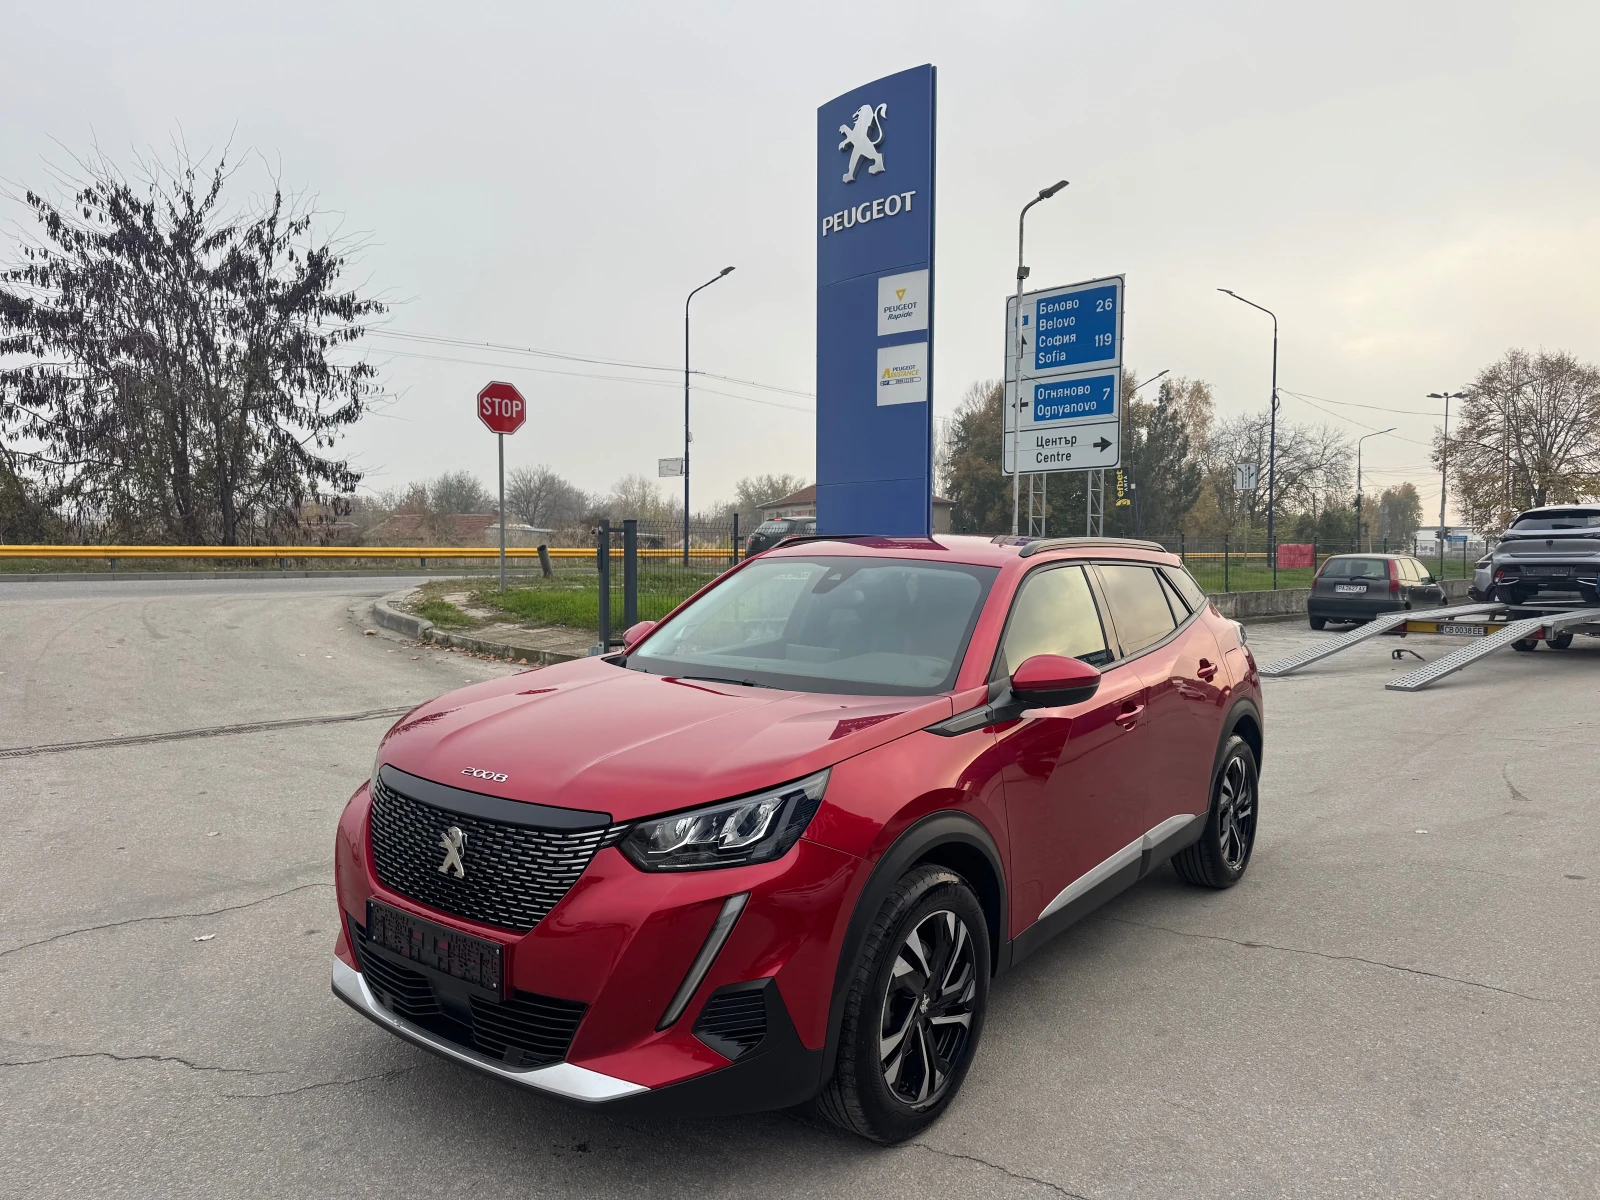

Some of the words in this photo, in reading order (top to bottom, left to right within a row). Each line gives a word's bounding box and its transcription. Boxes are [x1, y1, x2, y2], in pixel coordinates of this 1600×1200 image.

[822, 190, 917, 237] PEUGEOT
[884, 302, 918, 313] PEUGEOT
[1040, 299, 1079, 315] Белово
[1096, 298, 1113, 313] 26
[887, 311, 913, 321] Rapide
[1039, 316, 1076, 331] Belovo
[1039, 333, 1077, 348] София
[1095, 333, 1112, 347] 119
[1038, 350, 1066, 364] Sofia
[892, 364, 916, 372] PEUGEOT
[1037, 385, 1091, 400] Огняново
[1102, 387, 1111, 401] 7
[482, 396, 522, 418] STOP
[1037, 401, 1097, 418] Ognyanovo
[1036, 435, 1077, 449] Център
[1036, 451, 1072, 464] Centre
[1116, 469, 1124, 498] efbet
[1444, 626, 1454, 634] CB
[1454, 626, 1472, 635] 0038
[1472, 627, 1483, 635] EE
[461, 766, 508, 783] 2008
